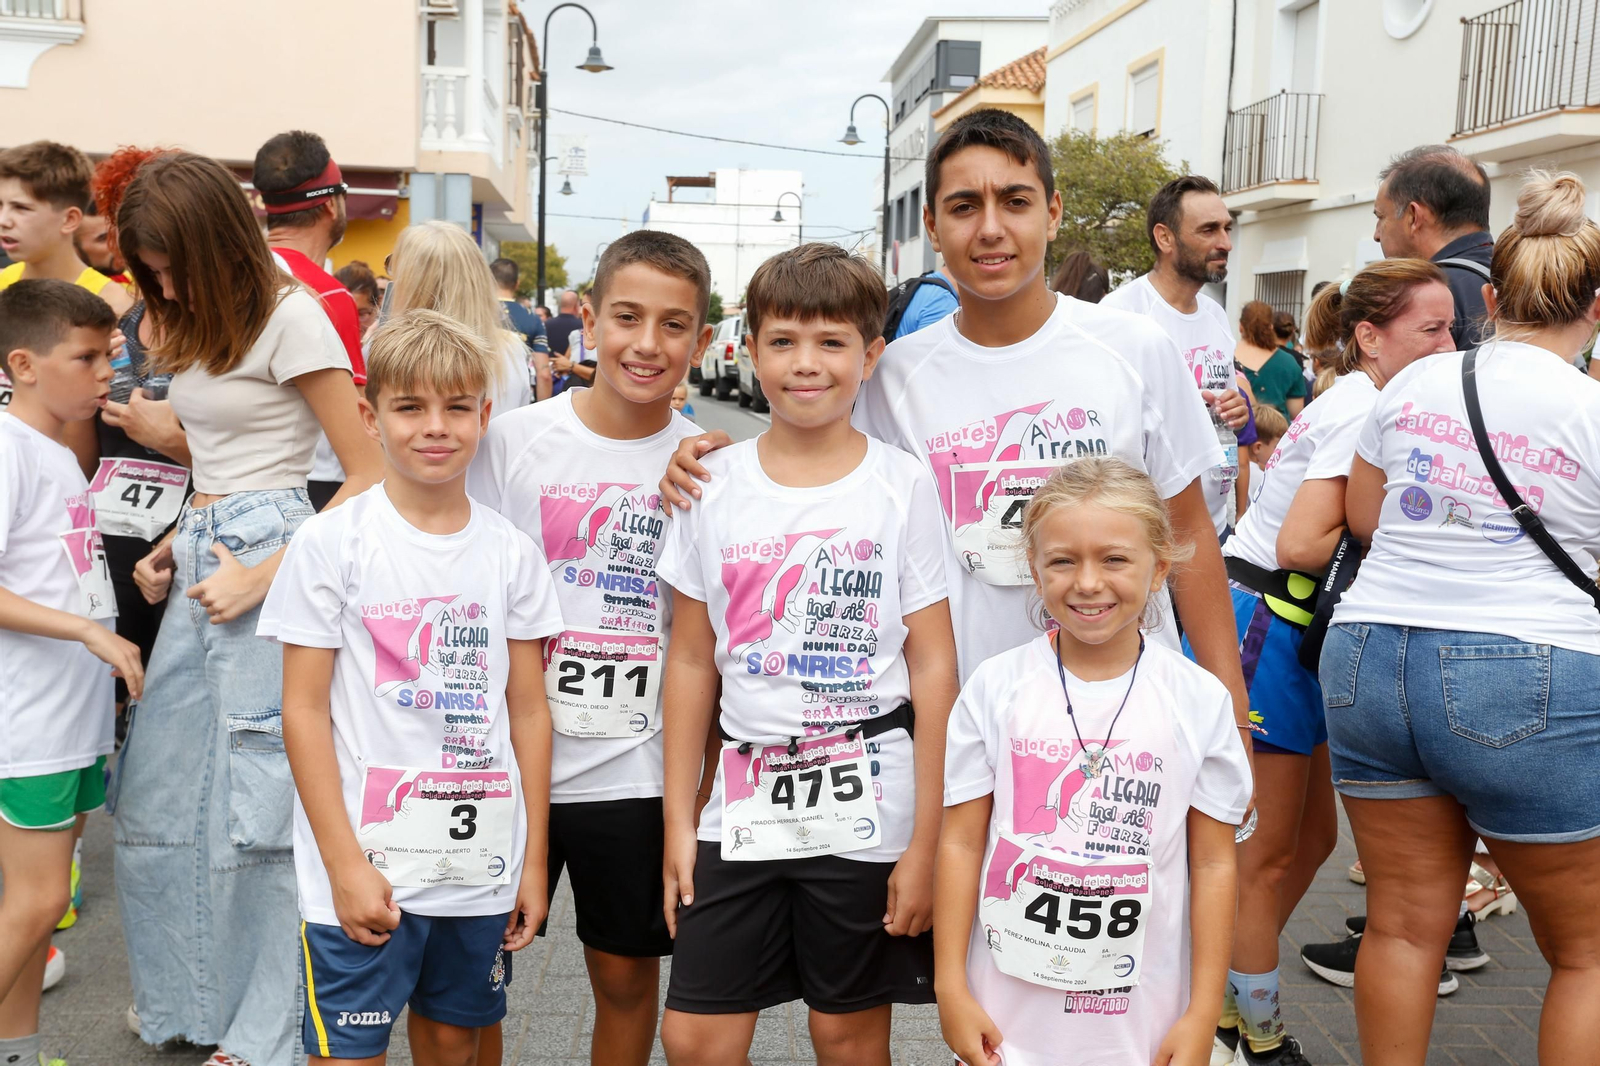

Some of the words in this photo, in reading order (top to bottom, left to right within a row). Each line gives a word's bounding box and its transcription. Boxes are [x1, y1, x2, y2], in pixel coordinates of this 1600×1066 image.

[1031, 407, 1102, 446] AMOR
[926, 425, 996, 451] valores
[540, 484, 597, 499] valores
[1407, 451, 1544, 513] depalmos
[121, 483, 164, 510] 47
[609, 547, 655, 568] FUERZ
[721, 541, 785, 562] valores
[815, 538, 883, 569] AMOR
[564, 566, 659, 598] SONRISA
[608, 564, 659, 581] HUMILDA
[807, 568, 883, 598] ALEGRIA
[1324, 561, 1341, 592] HANSEN
[361, 602, 421, 618] valores
[440, 602, 488, 627] AMOR
[807, 598, 879, 629] inclusión
[436, 626, 488, 648] ALEGRIA
[805, 618, 878, 642] FUERZA
[627, 643, 656, 654] valores
[803, 641, 877, 657] HUMILDAD
[437, 649, 488, 671] inclusión
[747, 651, 876, 679] SONRISA
[444, 681, 488, 693] HUMILDAD
[558, 660, 649, 698] 211
[397, 689, 488, 710] SONRISA
[802, 705, 879, 719] GRATITUD
[826, 741, 860, 755] valores
[1011, 738, 1071, 758] valores
[442, 753, 494, 769] Deporte
[1100, 751, 1163, 775] AMOR
[485, 780, 510, 791] valores
[771, 762, 864, 811] 475
[1091, 775, 1161, 808] ALEGRIA
[449, 804, 478, 840] 3
[801, 814, 824, 823] DANIEL
[1089, 802, 1153, 835] inclusión
[793, 845, 819, 853] Septiembre
[1085, 841, 1150, 856] HUMILDA
[1113, 875, 1146, 886] valores
[1024, 892, 1142, 940] 458
[1053, 944, 1087, 954] CLAUDIA
[1040, 973, 1073, 985] Septiembre
[337, 1010, 391, 1027] Joma
